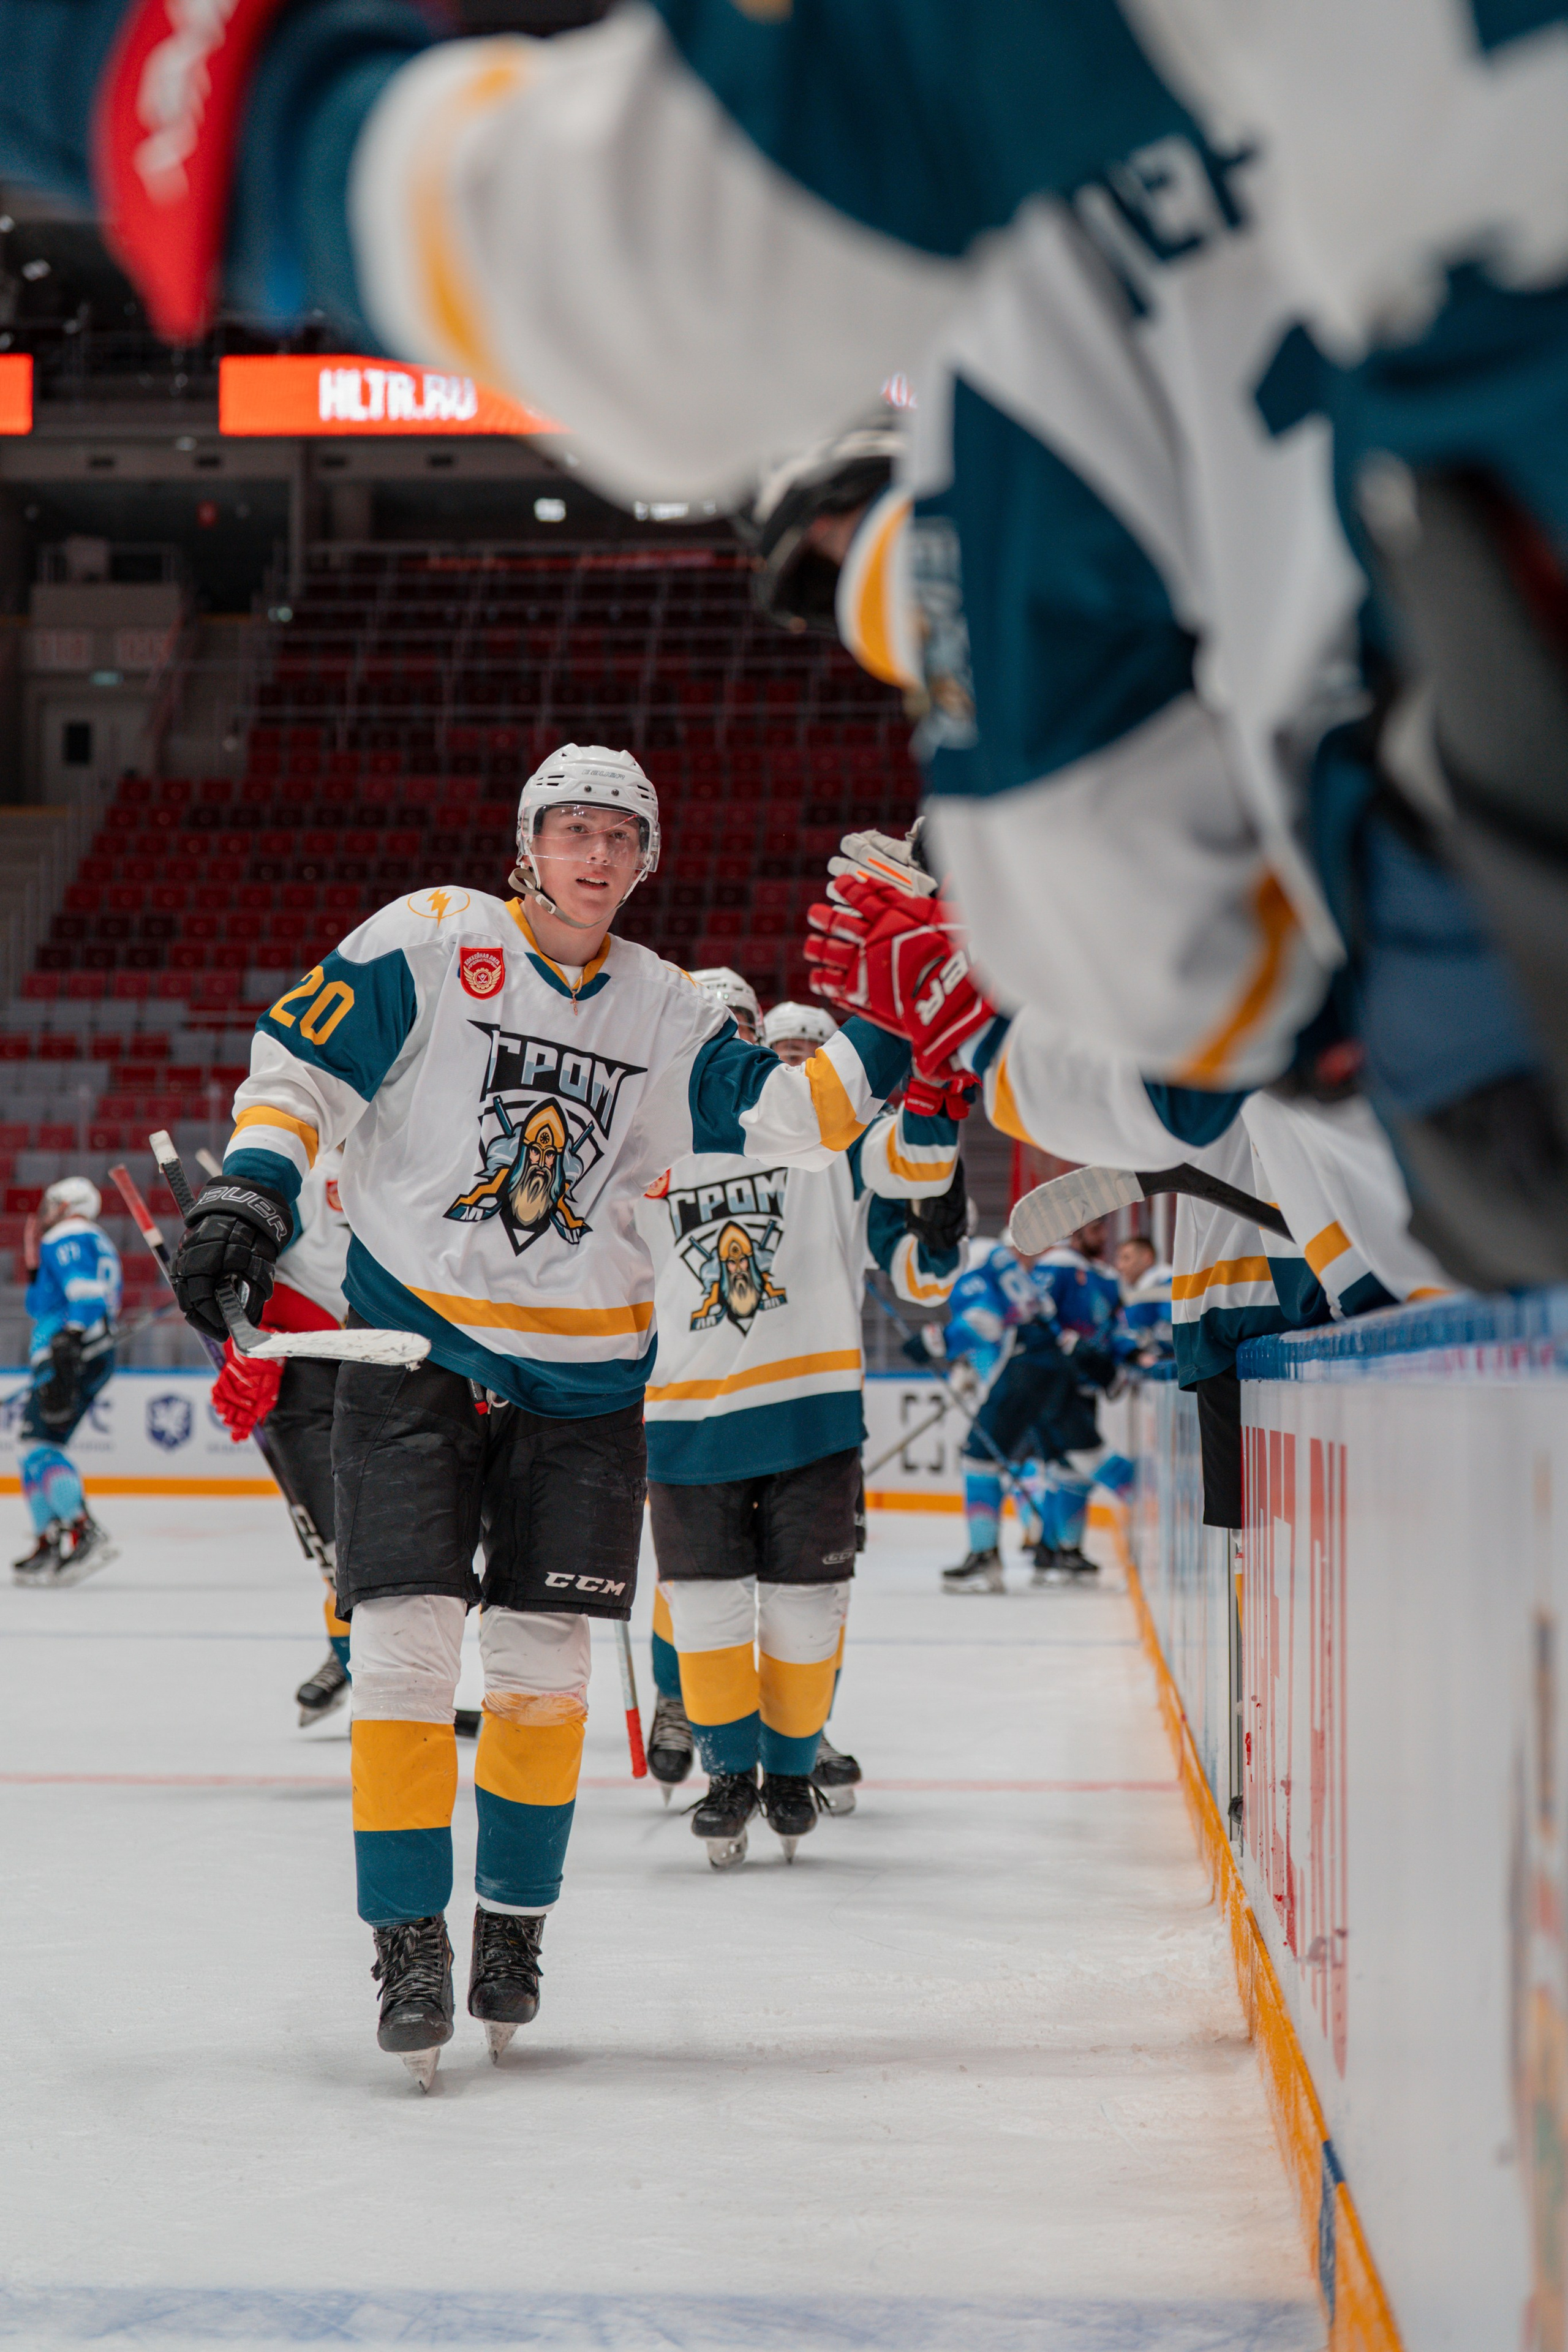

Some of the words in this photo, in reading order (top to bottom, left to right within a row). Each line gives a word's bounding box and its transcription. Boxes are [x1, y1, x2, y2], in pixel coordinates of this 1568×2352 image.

[319, 368, 478, 421] HLTR.RU
[269, 965, 355, 1046] 20
[486, 1029, 627, 1130] ГРОМ
[666, 1169, 789, 1241] ГРОМ
[545, 1572, 626, 1596] CCM
